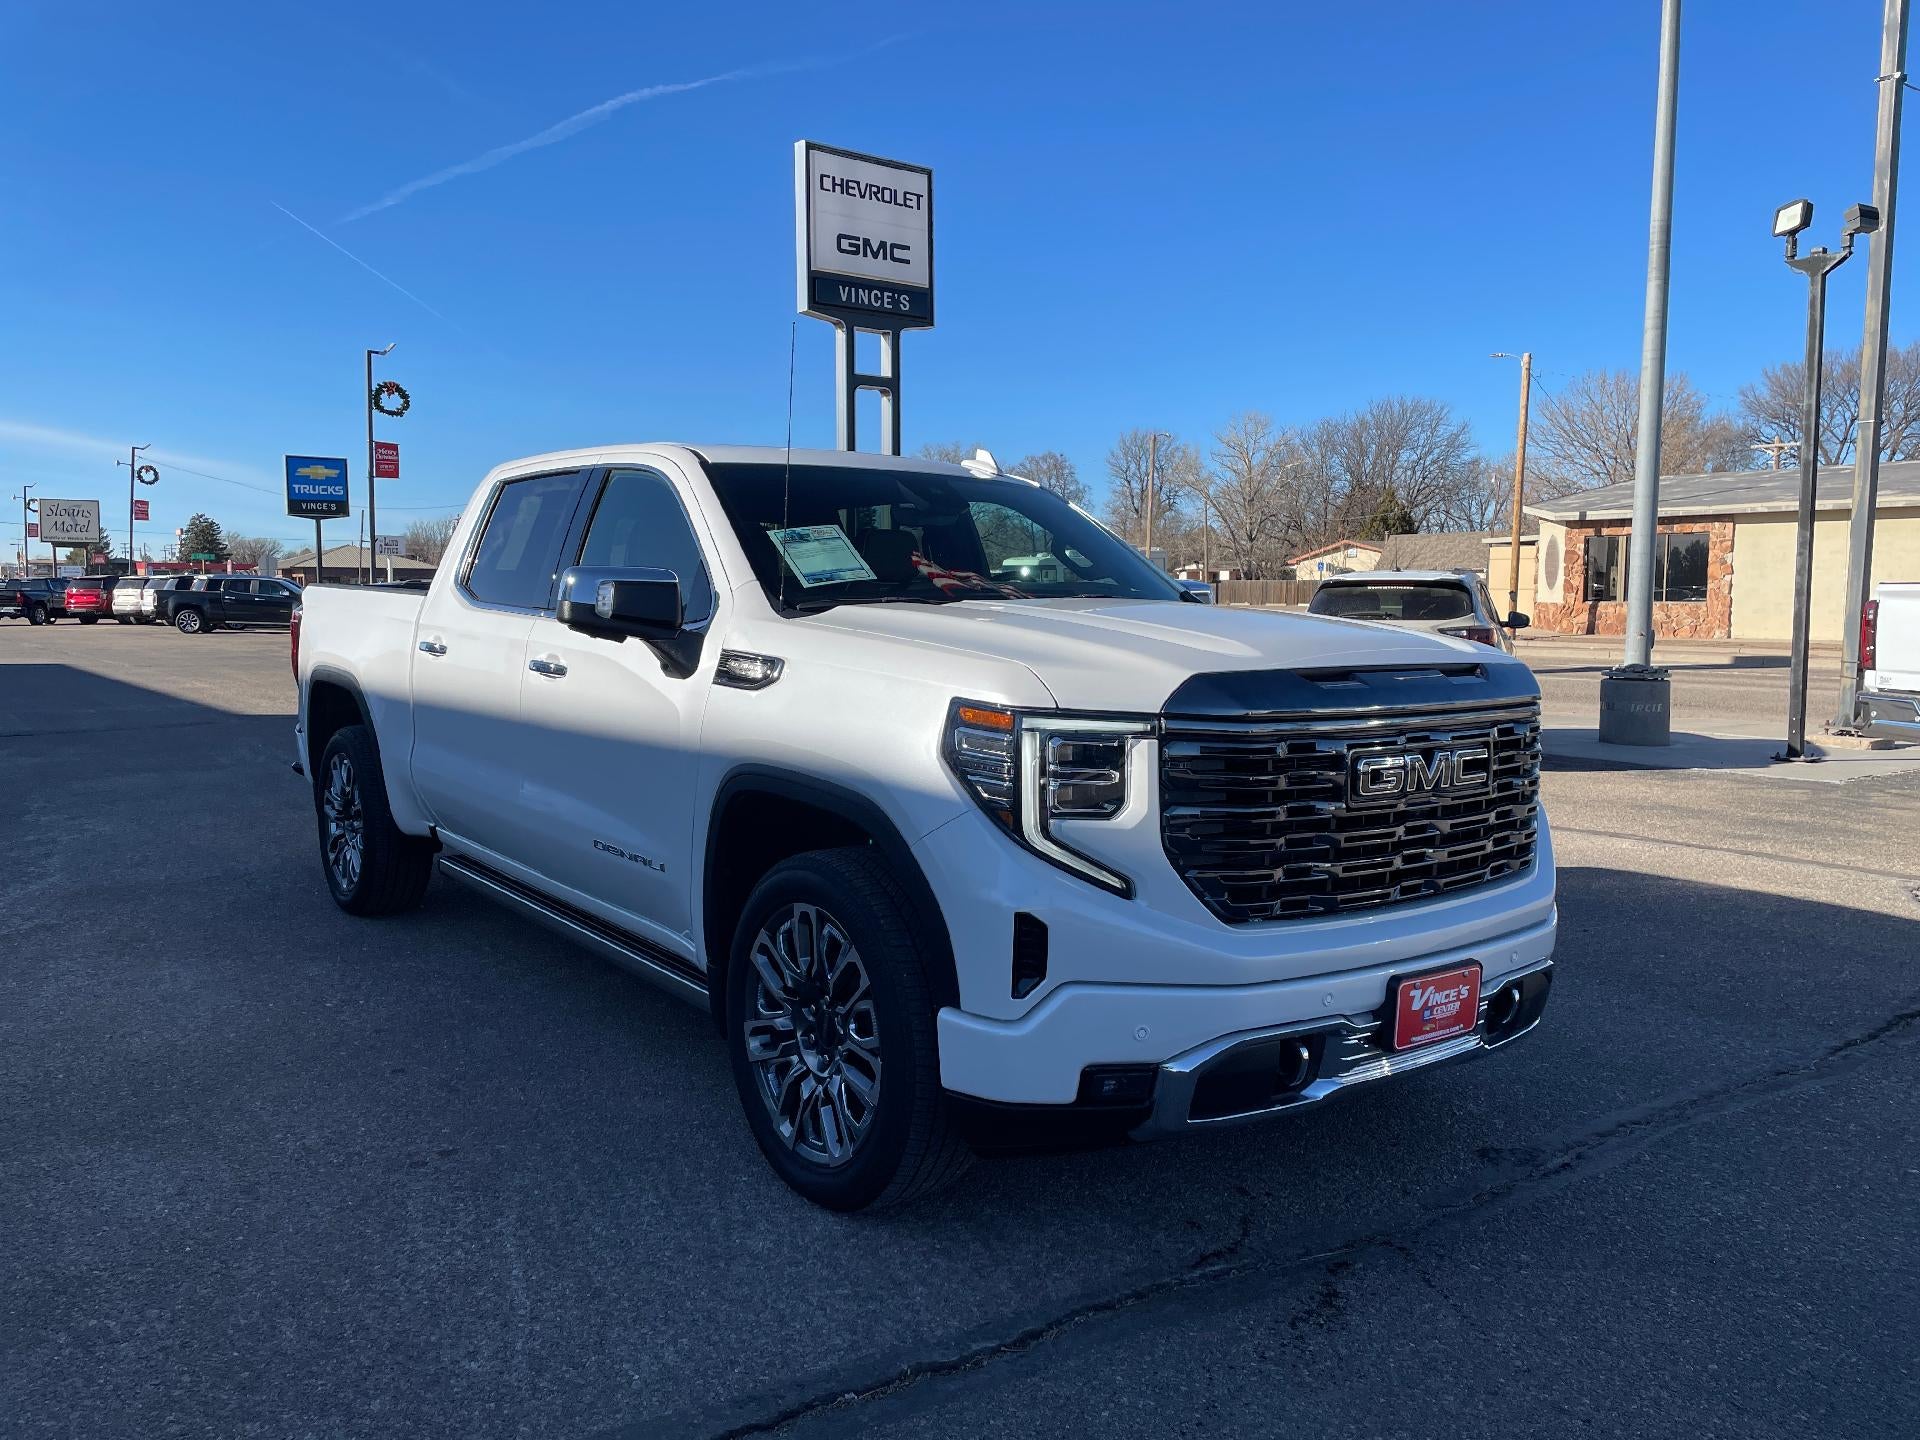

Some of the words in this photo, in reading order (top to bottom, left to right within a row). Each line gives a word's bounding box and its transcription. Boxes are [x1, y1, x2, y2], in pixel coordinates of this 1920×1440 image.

[819, 173, 924, 211] CHEVROLET
[836, 232, 911, 265] GMC
[838, 285, 910, 311] VINCE'S
[292, 484, 344, 495] TRUCKS
[301, 502, 337, 511] VINCE'S
[48, 519, 91, 533] Motel
[1357, 748, 1489, 796] GMC
[592, 839, 666, 873] DENALI
